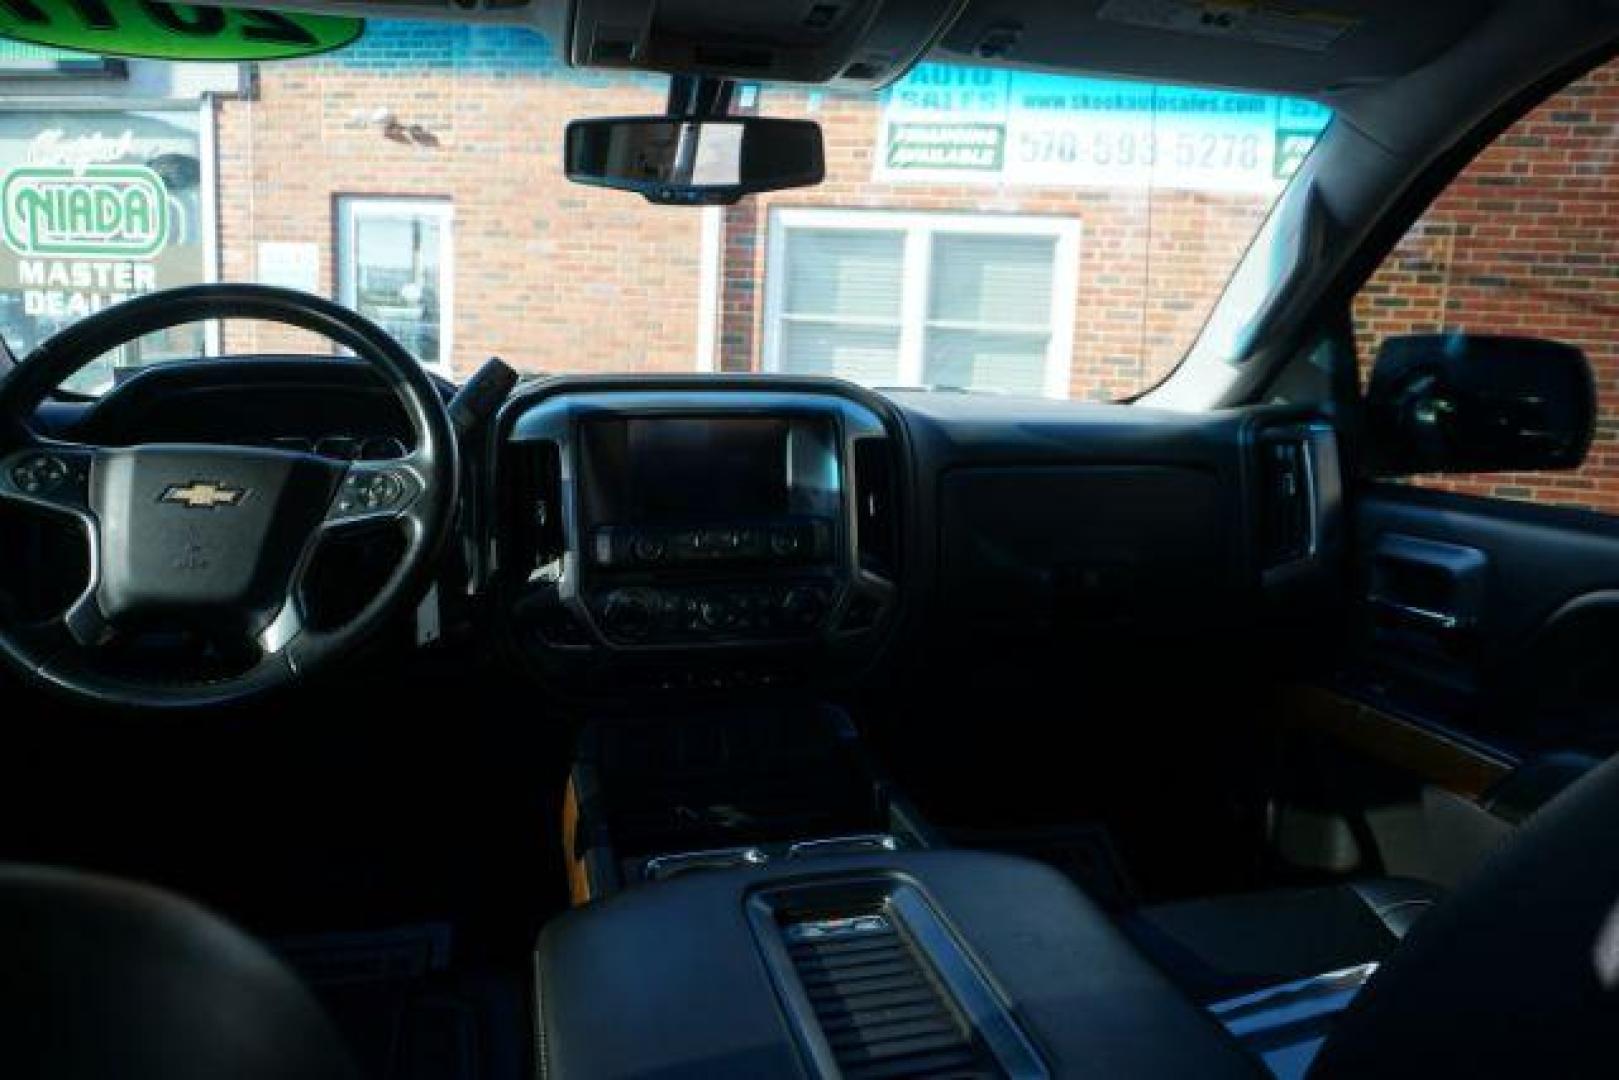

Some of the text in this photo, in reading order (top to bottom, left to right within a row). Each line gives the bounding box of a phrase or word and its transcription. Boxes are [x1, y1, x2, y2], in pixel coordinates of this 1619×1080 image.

[902, 90, 998, 112] SALES
[15, 186, 151, 240] NIADA
[19, 260, 156, 290] MASTER
